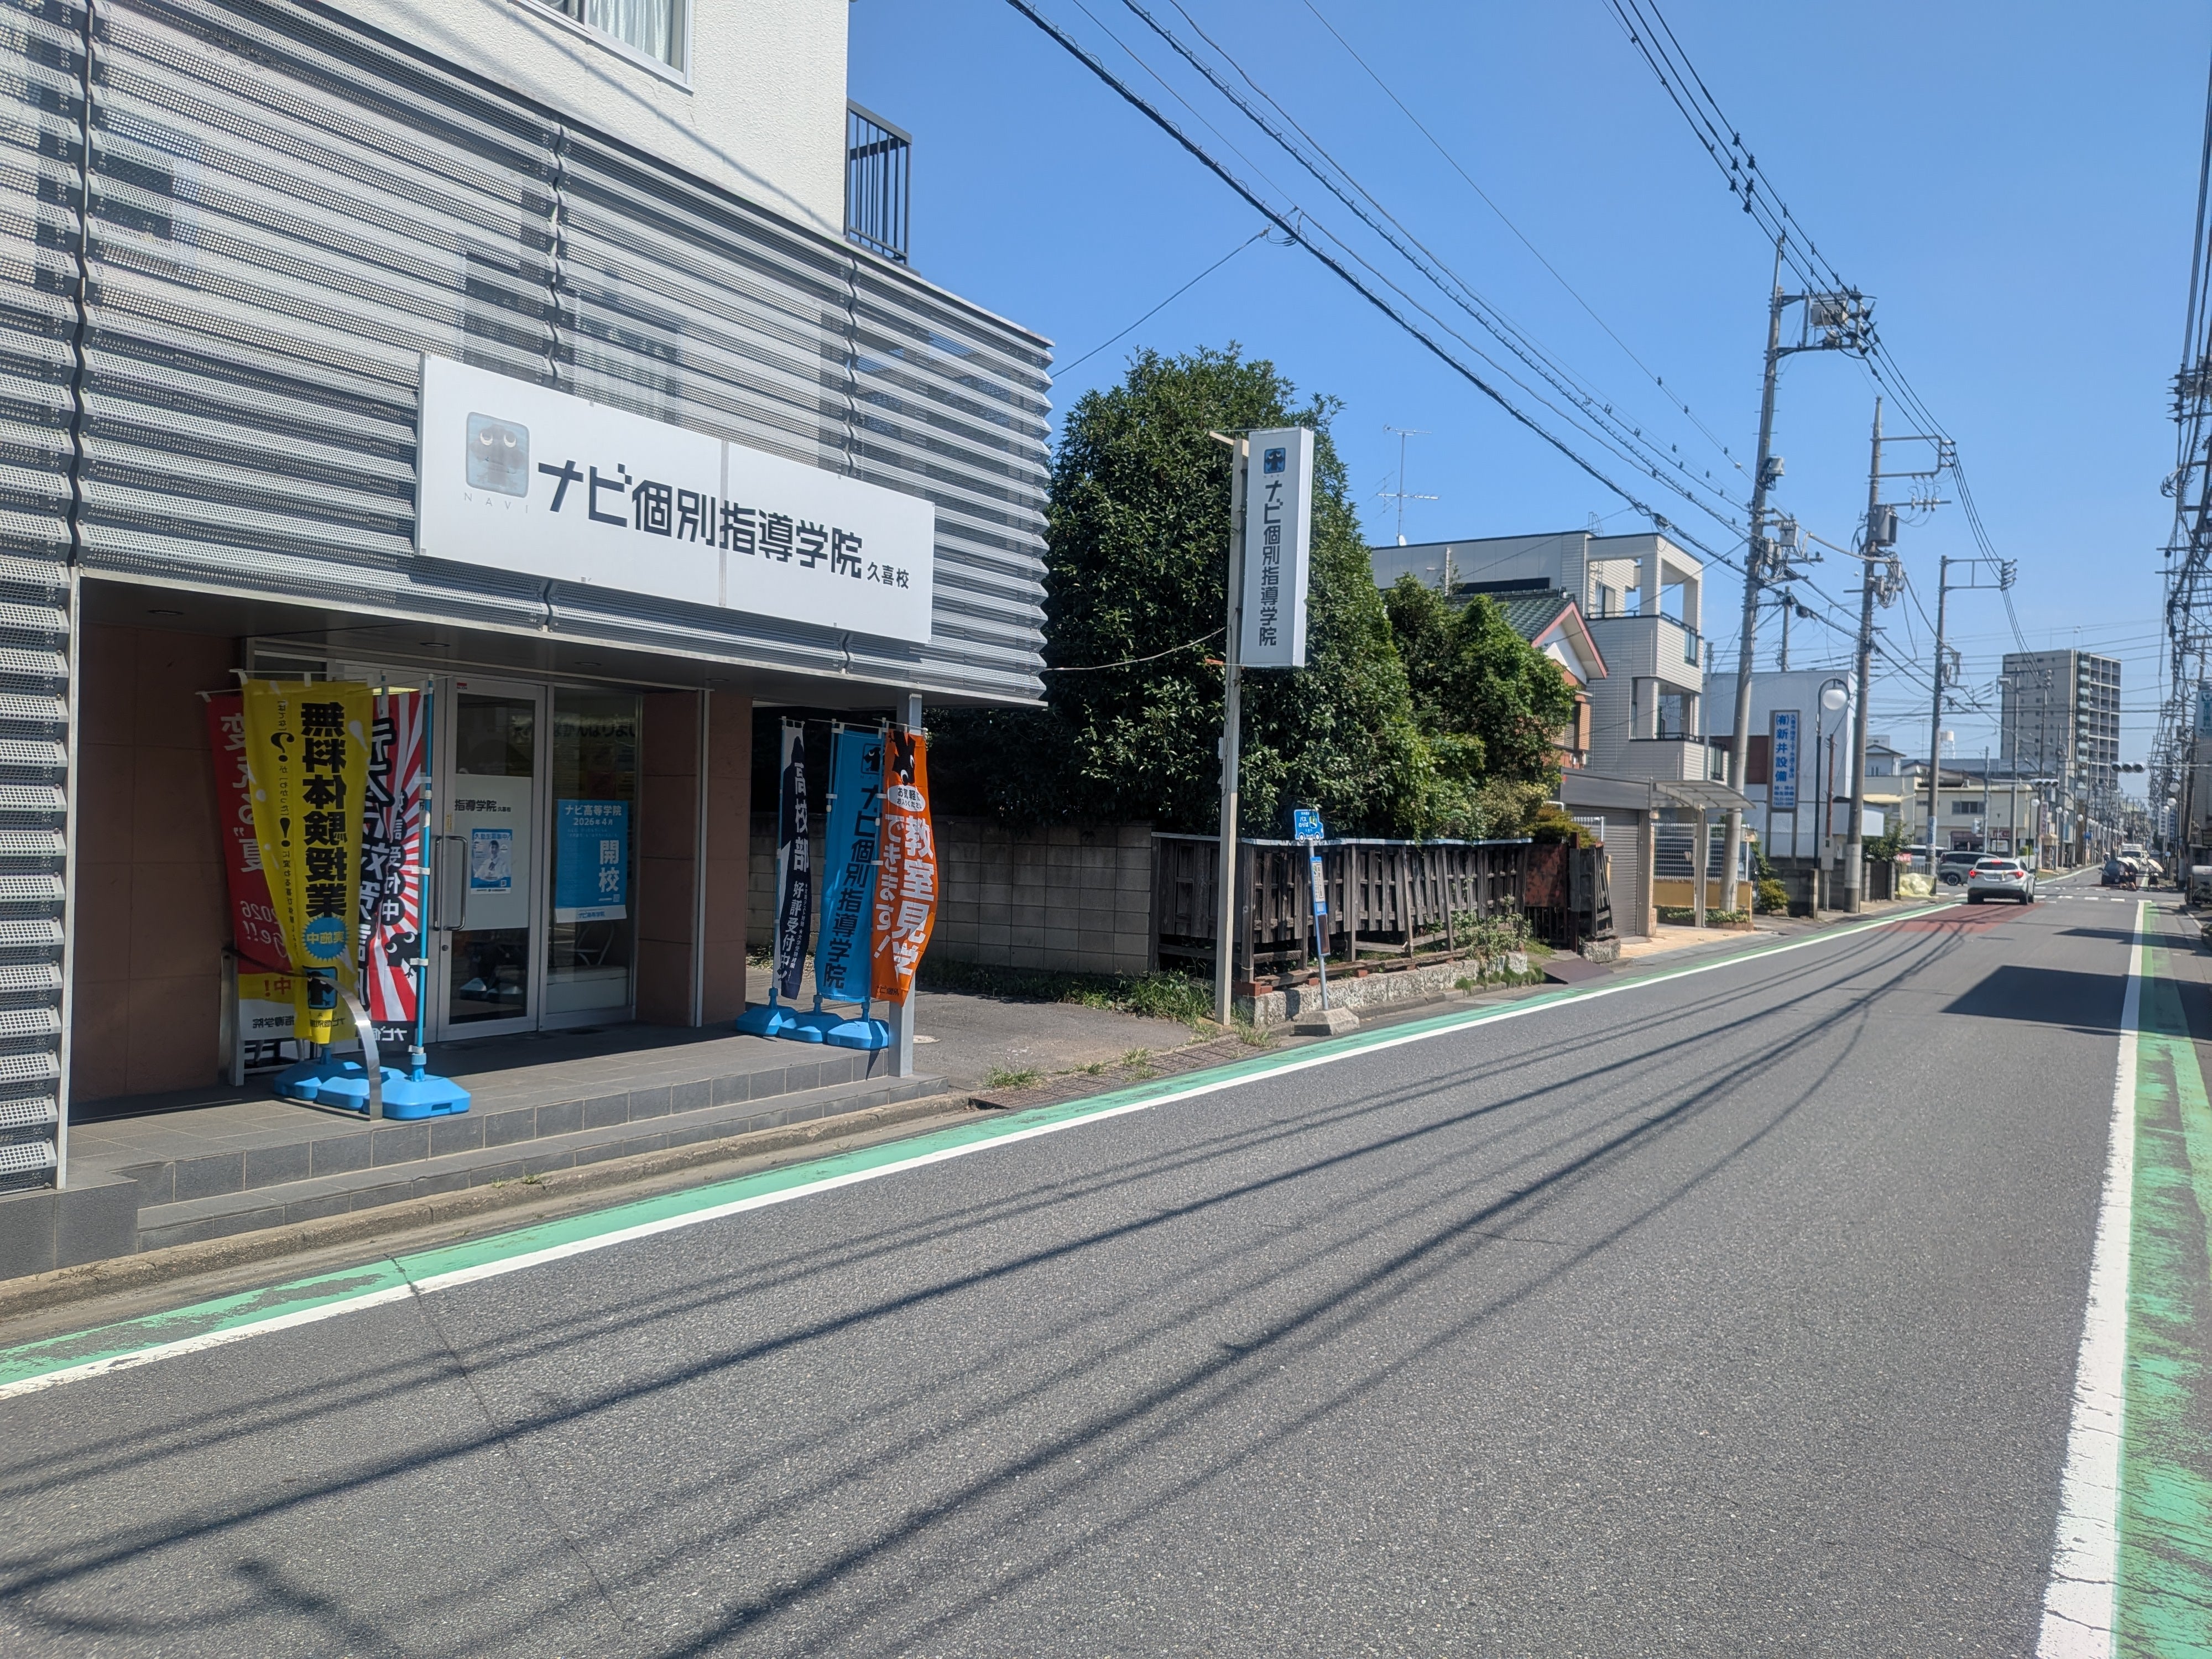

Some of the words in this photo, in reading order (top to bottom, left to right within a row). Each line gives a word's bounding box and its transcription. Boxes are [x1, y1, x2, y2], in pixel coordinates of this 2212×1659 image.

[464, 492, 529, 513] NAVI
[538, 459, 863, 579] ナビ個別指導学院
[867, 561, 910, 590] 久喜校
[1259, 480, 1284, 646] ナビ個別指導学院
[565, 804, 623, 817] ナビ高等学院
[573, 817, 619, 826] 2026年4月
[598, 839, 620, 893] 開校
[794, 761, 810, 873] 高校部
[824, 784, 883, 989] ナビ個別指導学院
[873, 813, 905, 959] できます!
[891, 814, 934, 983] 教室見学
